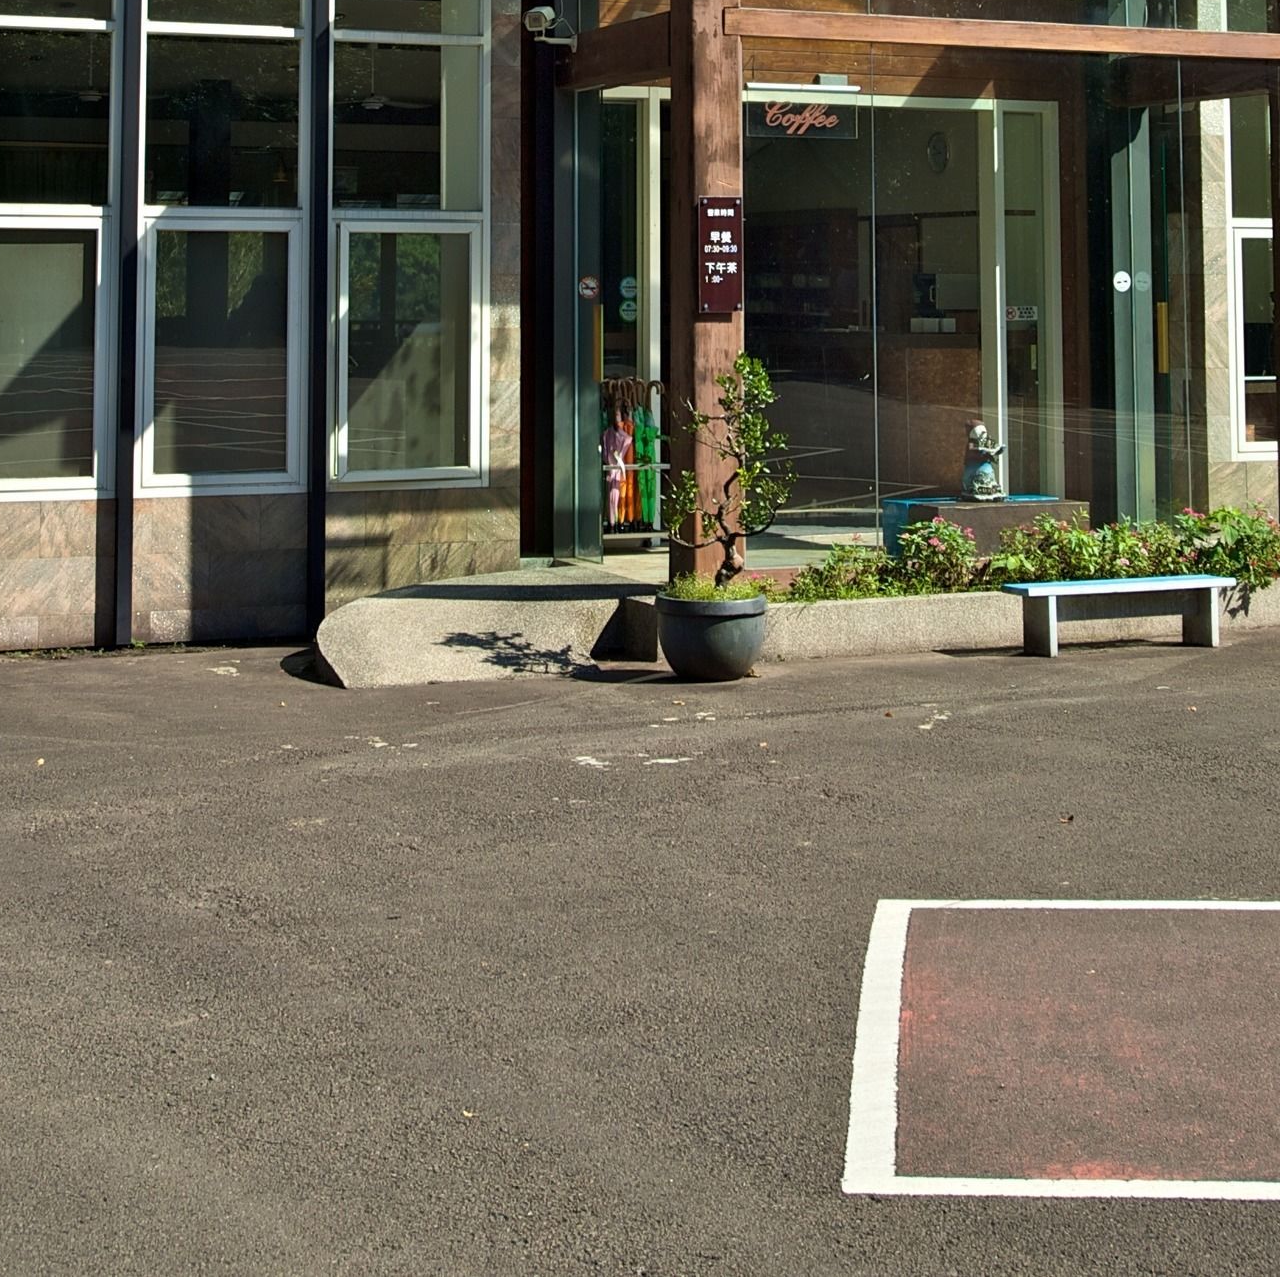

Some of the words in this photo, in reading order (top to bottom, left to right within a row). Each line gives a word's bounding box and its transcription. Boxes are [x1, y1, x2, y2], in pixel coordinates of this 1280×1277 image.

[765, 100, 840, 135] Coffee
[710, 231, 732, 243] 早餐
[705, 262, 738, 274] 下午茶
